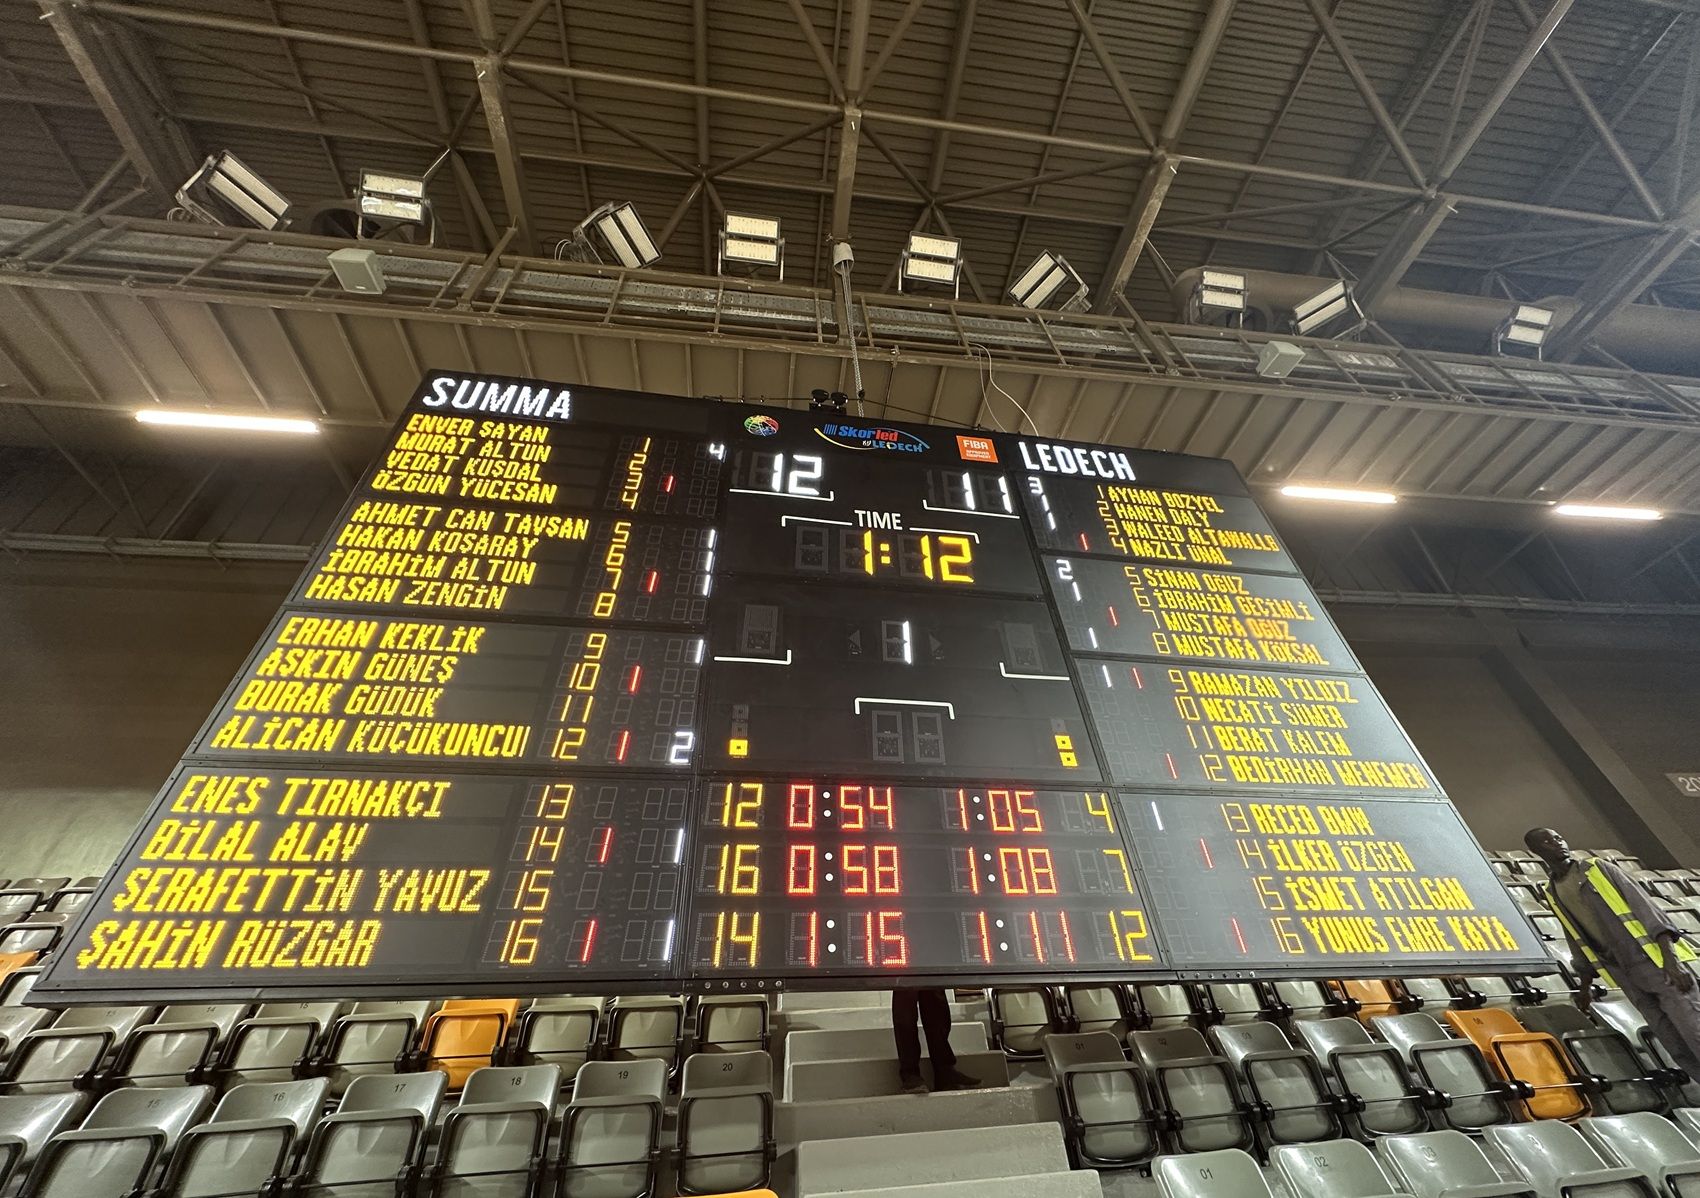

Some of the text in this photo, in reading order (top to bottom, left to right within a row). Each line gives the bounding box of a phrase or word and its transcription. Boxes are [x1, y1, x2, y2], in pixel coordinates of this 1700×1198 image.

[422, 377, 572, 420] SUMMA
[405, 413, 474, 436] ENVER
[839, 424, 898, 441] Skorled
[394, 431, 551, 463] MURAT ALTUN
[642, 437, 651, 454] 1
[709, 442, 726, 460] 4
[872, 440, 923, 452] LEDECH
[962, 440, 988, 450] FIBA
[386, 450, 459, 474] VEDAT
[629, 453, 647, 471] 2
[771, 453, 824, 496] 12
[1018, 441, 1137, 481] LEDECH
[371, 469, 558, 505] ÖZGÜN YÜCESAN
[625, 473, 642, 490] 3
[962, 471, 1013, 514] 11
[1027, 476, 1042, 495] 3
[622, 492, 640, 510] 4
[1097, 500, 1111, 517] 2
[1107, 486, 1224, 513] AYHAN BOZYEL
[350, 500, 441, 527] AHMET
[444, 508, 495, 532] CAN
[854, 509, 903, 531] TIME
[1104, 518, 1119, 536] 3
[1113, 502, 1210, 528] HANEN DALY
[336, 523, 426, 551] HAKAN
[613, 522, 632, 543] 5
[1111, 537, 1128, 554] 4
[1121, 520, 1186, 543] WALEED
[605, 544, 626, 566] 6
[863, 530, 975, 583] 1:12
[1128, 538, 1233, 565] NAZLI ÜNAL
[321, 548, 537, 585] İBRAHİM ALTUN
[606, 567, 623, 590] 7
[1055, 559, 1073, 581] 2
[1124, 566, 1141, 585] 5
[1143, 567, 1202, 591] SİNAN
[304, 573, 508, 610] HASAN ZENGİN
[593, 593, 616, 618] 8
[1132, 587, 1151, 607] 6
[1152, 588, 1236, 615] İBRAHİM
[1142, 609, 1161, 629] 7
[1162, 610, 1248, 638] MUSTAFA
[276, 616, 486, 654] ERHAN KEKLİK
[584, 633, 607, 659] 9
[1152, 632, 1171, 654] 8
[1171, 633, 1330, 666] MUSTAFA KÖKSAL
[363, 652, 459, 684] GÜNEŞ
[569, 662, 600, 691] 10
[1168, 669, 1188, 693] 9
[234, 679, 444, 718] BURAK GÜDÜK
[1188, 670, 1359, 704] RAMAZAN YILDIZ
[560, 694, 594, 723] 11
[1174, 695, 1200, 720] 10
[1199, 696, 1349, 729] NECATİ SÜMER
[210, 715, 346, 752] ALİCAN
[552, 728, 586, 760] 12
[670, 731, 694, 763] 2
[1186, 725, 1214, 749] 11
[1212, 725, 1353, 757] BERAT KALEM
[1199, 754, 1227, 782] 12
[1226, 754, 1430, 789] BEDİRHAN MENEMEN
[170, 775, 452, 818] ENES TIRNAKÇI
[1678, 776, 1700, 792] 20
[537, 784, 574, 819] 13
[723, 782, 1115, 833] 12 0:54 1:05 4
[1222, 802, 1250, 832] 13
[1248, 803, 1375, 836] RECEB BMW
[139, 819, 261, 861] BİLAL
[525, 826, 565, 862] 14
[1236, 839, 1268, 869] 14
[718, 844, 1134, 895] 16 0:58 1:08 7
[1267, 839, 1416, 872] İLKER ÖZGEN
[372, 868, 492, 913] YAVUZ
[513, 870, 555, 911] 15
[1252, 876, 1286, 911] 15
[1284, 875, 1475, 911] İSMET ATILGAN
[222, 919, 382, 968] RÜZGAR
[500, 919, 543, 964] 16
[714, 910, 1153, 967] 14 1:15 1:11 12
[1270, 916, 1305, 954] 16
[1302, 915, 1520, 953] YUNUS EMRE KAYA
[618, 1070, 629, 1081] 19
[722, 1062, 733, 1072] 20
[394, 1083, 406, 1094] 17
[510, 1076, 522, 1087] 18
[1200, 1167, 1213, 1180] 01
[1314, 1156, 1329, 1168] 02
